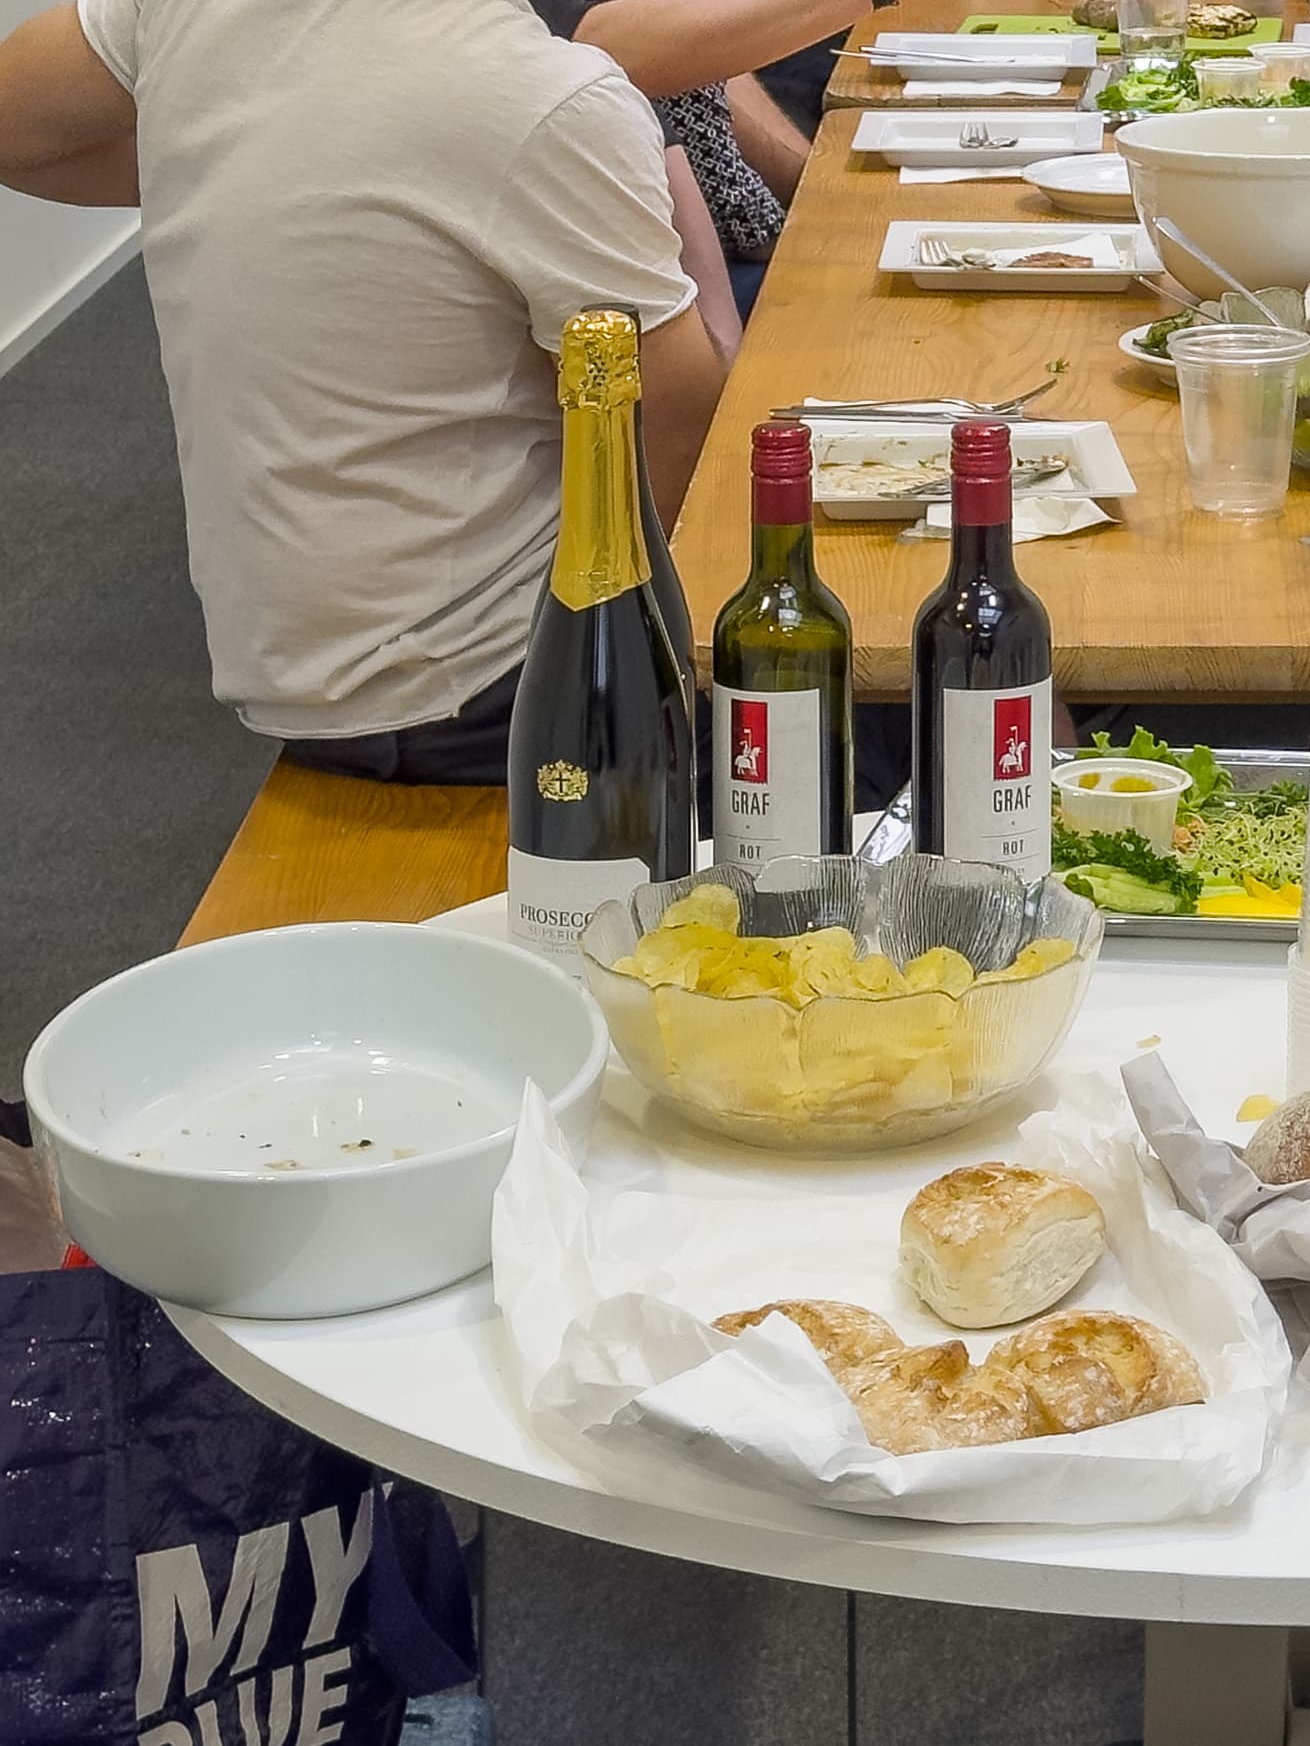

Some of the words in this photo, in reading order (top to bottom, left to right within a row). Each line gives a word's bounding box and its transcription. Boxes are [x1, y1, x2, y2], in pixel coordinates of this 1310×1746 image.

[732, 789, 770, 815] GRAF
[993, 785, 1032, 813] GRAF
[739, 844, 761, 859] ROT
[1003, 839, 1024, 854] ROT
[520, 903, 594, 927] PROSEC
[136, 1482, 393, 1720] MY
[137, 1647, 352, 1746] UE
